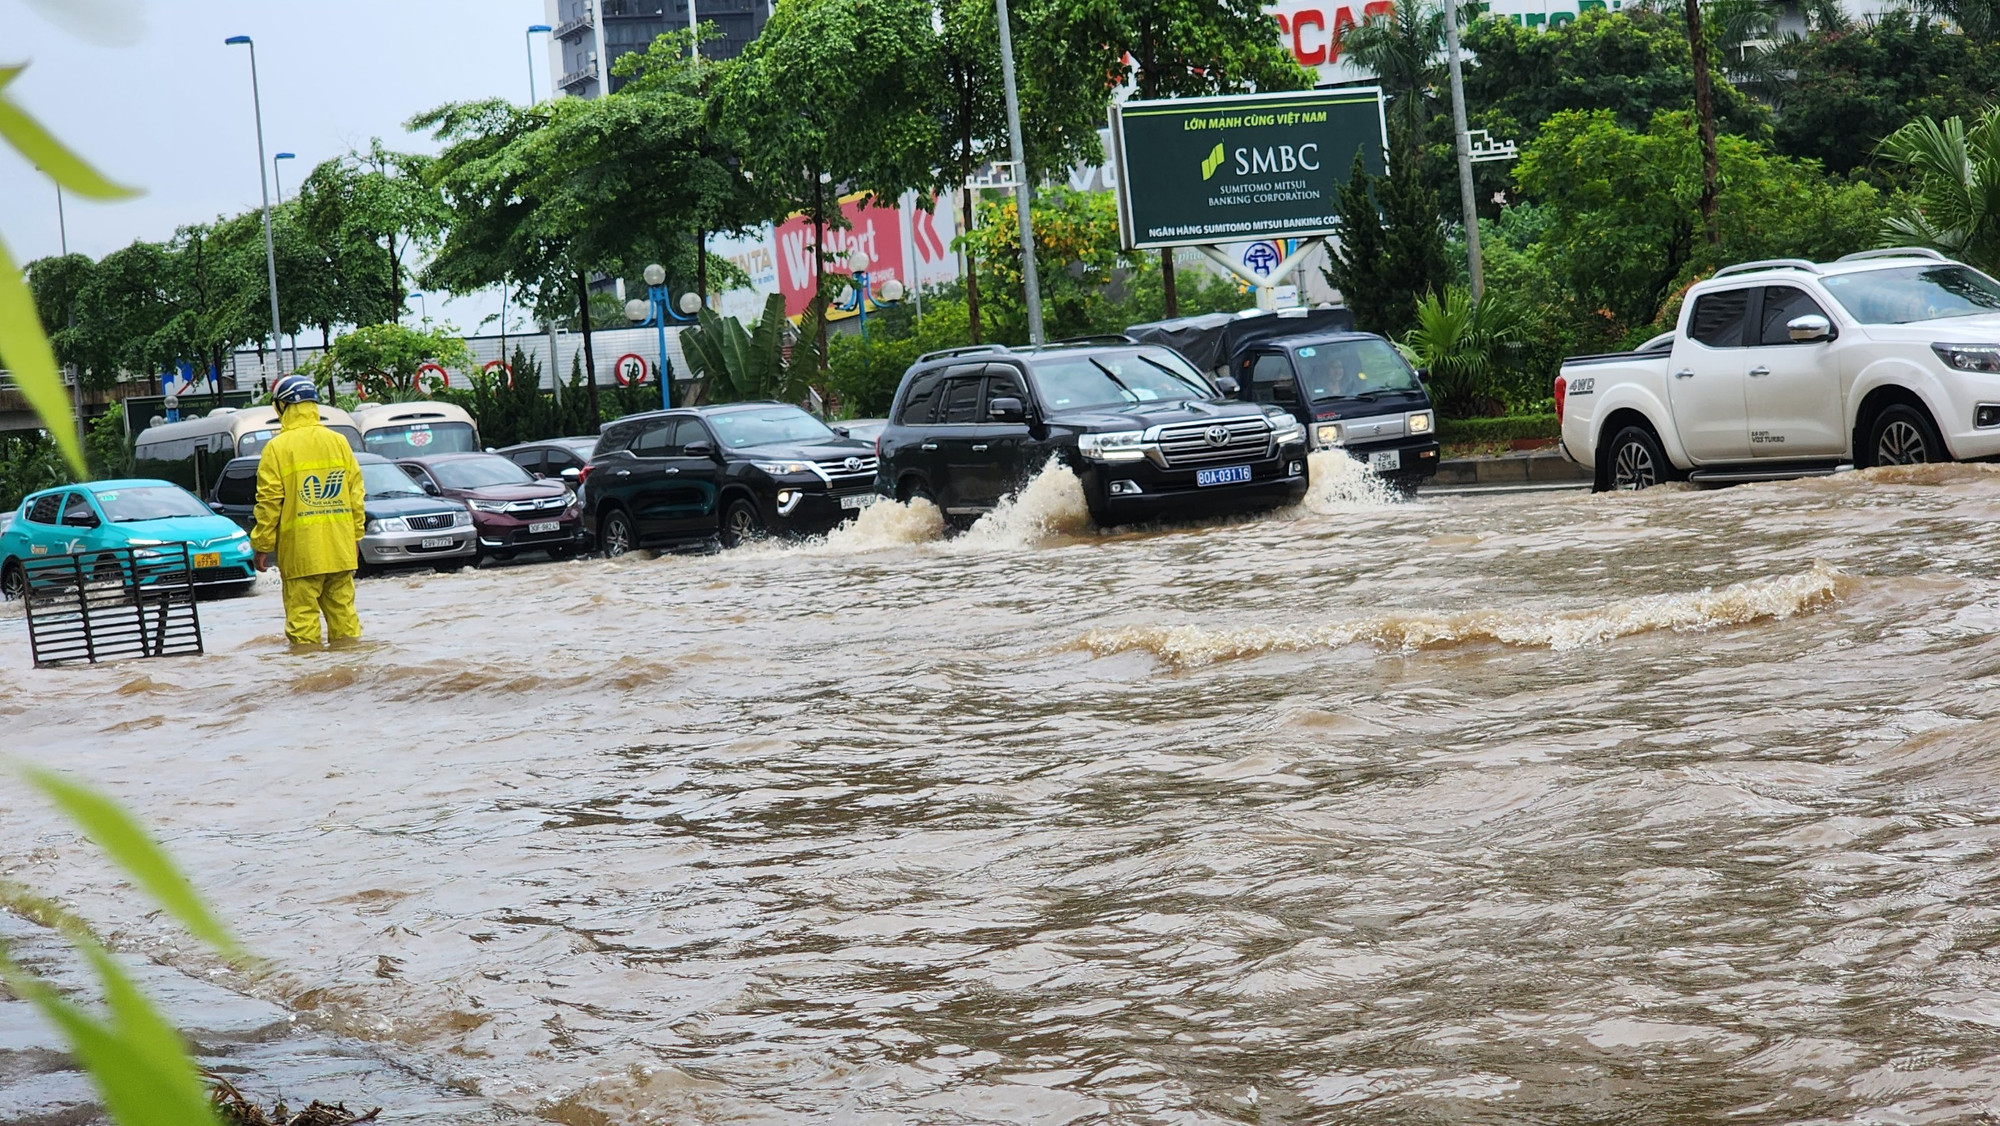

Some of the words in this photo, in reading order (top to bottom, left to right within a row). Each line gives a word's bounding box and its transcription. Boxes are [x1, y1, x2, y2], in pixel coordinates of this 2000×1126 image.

[1184, 118, 1207, 131] LỚN
[1208, 117, 1242, 131] MẠNH
[1243, 114, 1275, 127] CÙNG
[1276, 112, 1300, 127] VIỆT
[1301, 111, 1327, 123] NAM
[1234, 143, 1320, 176] SMBC
[1220, 182, 1272, 194] SUMITOMO
[1274, 180, 1306, 191] MITSUI
[1208, 195, 1251, 206] BANKING
[1253, 190, 1320, 203] CORPORATION
[1149, 225, 1175, 237] NGÂN
[1176, 224, 1202, 236] HÀNG
[1203, 222, 1251, 234] SUMITOMO
[1252, 219, 1282, 231] MITSUI
[1283, 216, 1322, 228] BANKING
[1323, 215, 1343, 225] COR
[1569, 377, 1595, 391] 4WD
[1198, 467, 1250, 484] 80A-031.16
